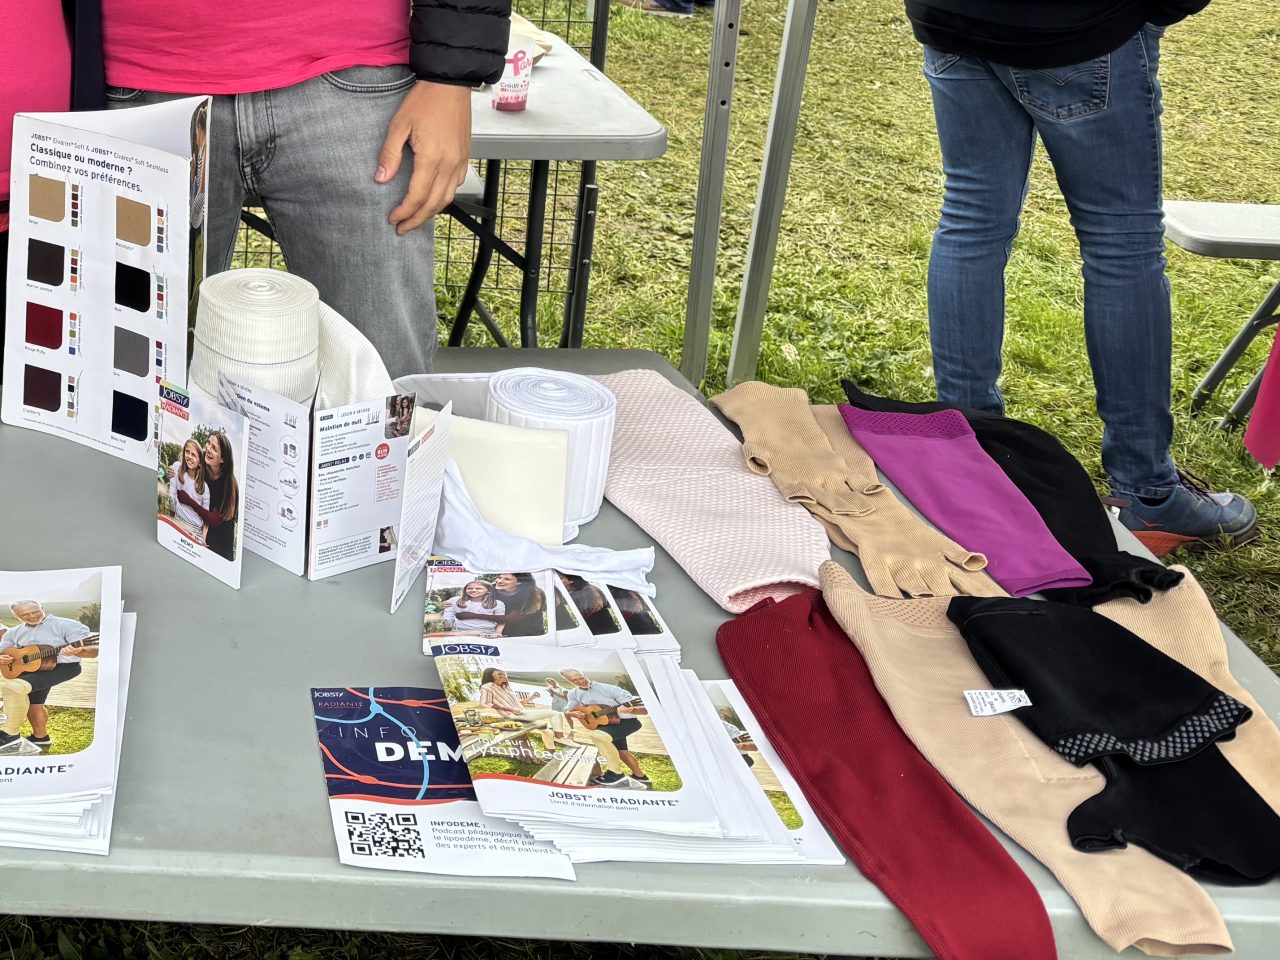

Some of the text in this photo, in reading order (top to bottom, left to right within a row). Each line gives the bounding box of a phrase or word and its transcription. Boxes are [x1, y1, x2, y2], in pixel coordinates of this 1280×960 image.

[30, 143, 133, 176] Classique ou moderne ?
[30, 156, 143, 193] Combinez vos préférences.
[163, 390, 184, 407] JOBST
[161, 400, 190, 422] RADIANTE
[441, 644, 489, 655] JOBST
[314, 691, 340, 699] JOBST
[339, 726, 417, 739] INFO
[505, 739, 525, 747] sur
[527, 739, 537, 748] le
[374, 741, 468, 762] DEM
[471, 742, 610, 766] lymphœdème
[549, 798, 570, 807] Livret
[571, 801, 615, 811] d'information
[432, 827, 466, 835] Podcast
[468, 828, 522, 839] pédagogique
[453, 843, 488, 851] experts
[493, 837, 519, 845] décrit
